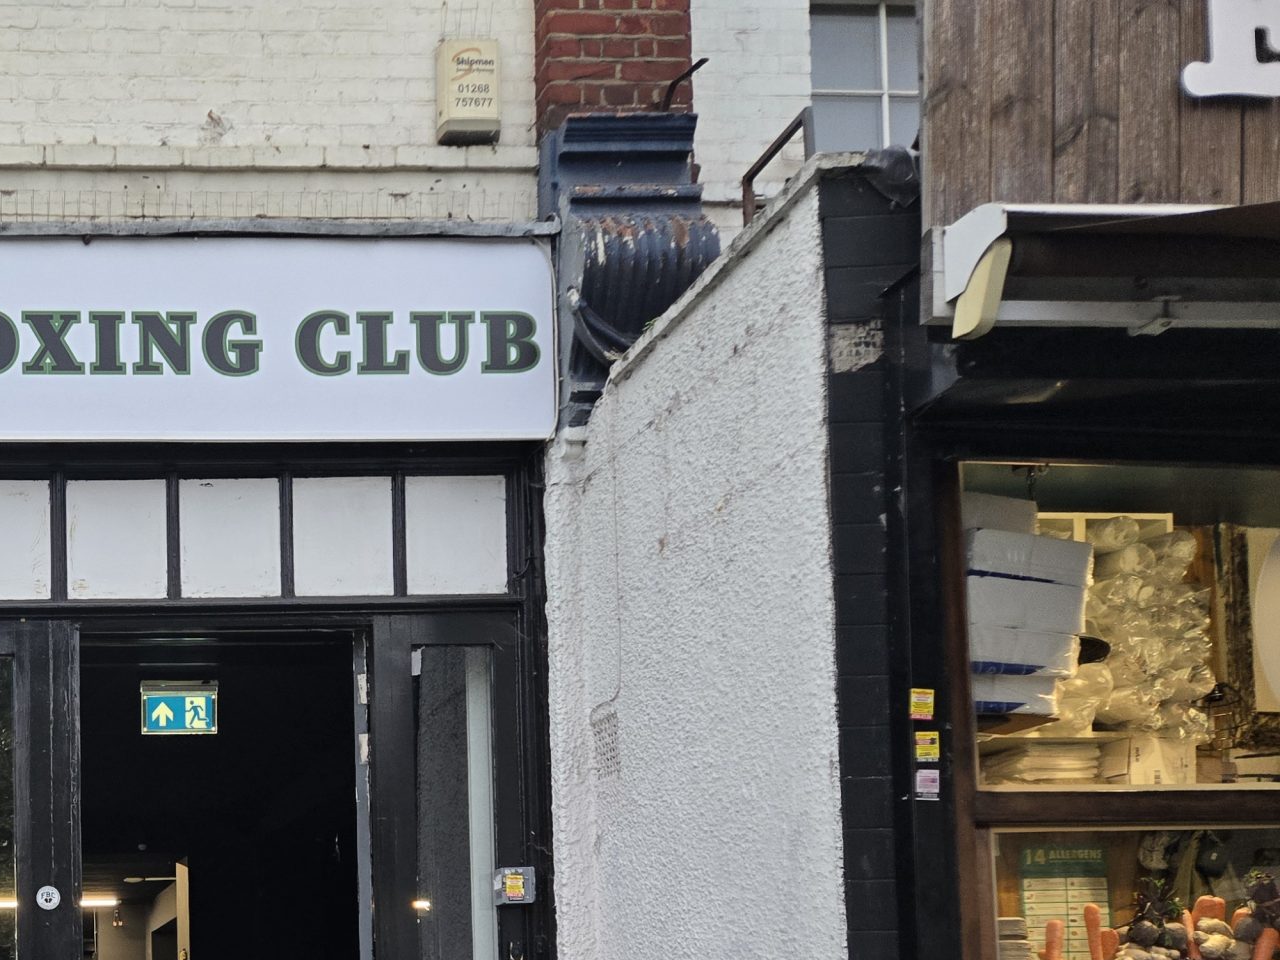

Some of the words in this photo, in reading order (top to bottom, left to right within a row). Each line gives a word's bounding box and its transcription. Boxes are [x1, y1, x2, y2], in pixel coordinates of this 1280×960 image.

[457, 84, 490, 93] 01268
[455, 98, 493, 107] 757677
[295, 309, 544, 377] CLUB
[1025, 849, 1046, 864] 14
[1049, 849, 1102, 859] ALLERGENS
